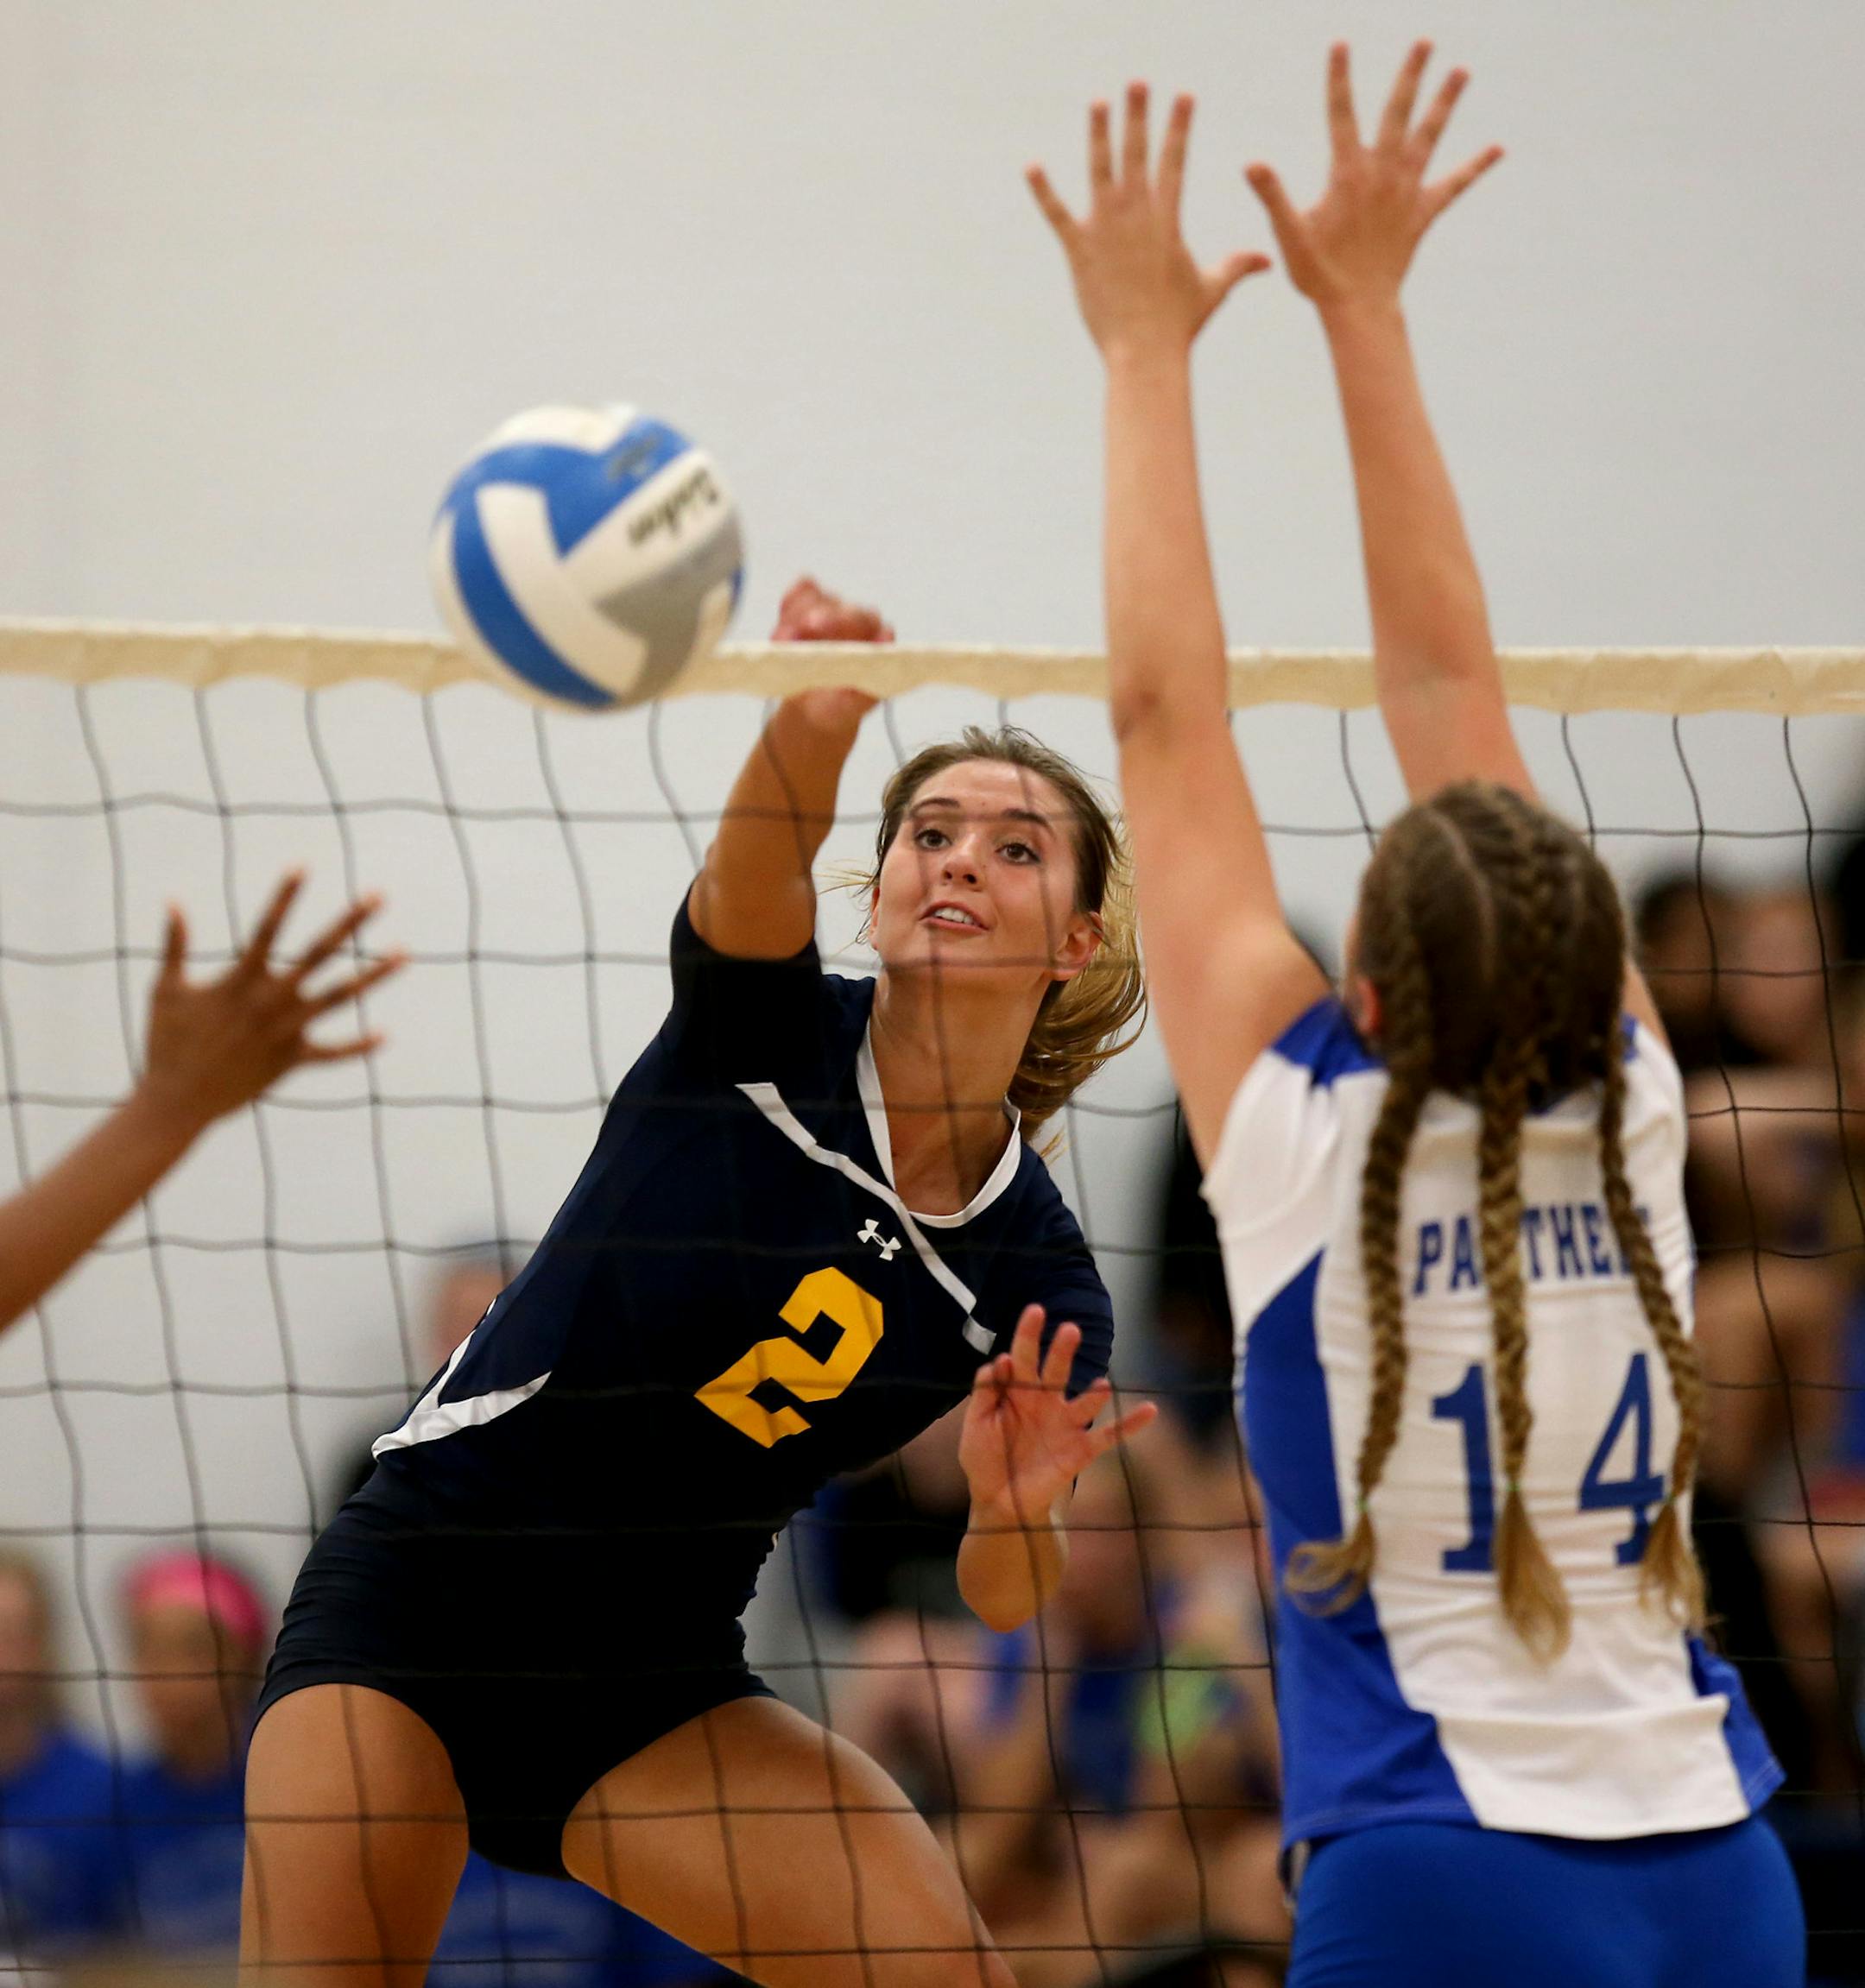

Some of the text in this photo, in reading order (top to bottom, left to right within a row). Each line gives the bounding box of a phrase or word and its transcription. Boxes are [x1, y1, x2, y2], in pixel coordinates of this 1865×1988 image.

[1412, 1203, 1648, 1295] PATHE
[693, 1266, 884, 1448] 2
[1431, 1353, 1664, 1572] 14
